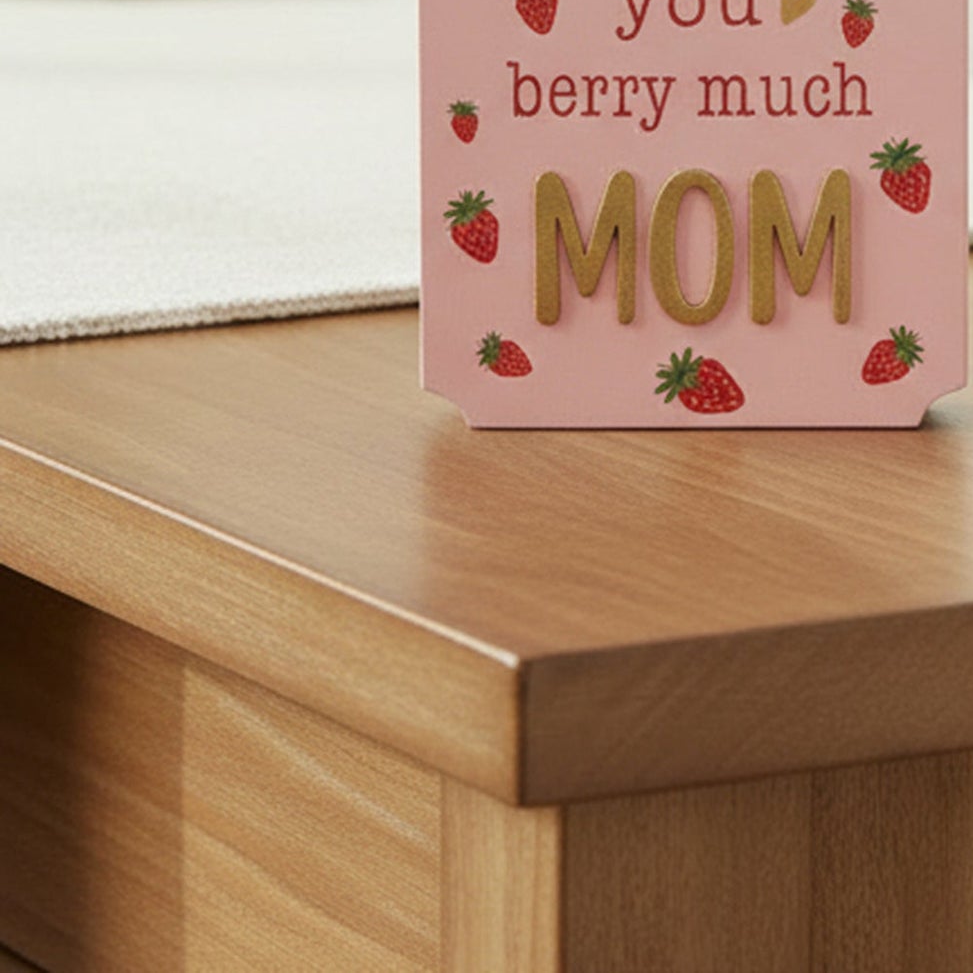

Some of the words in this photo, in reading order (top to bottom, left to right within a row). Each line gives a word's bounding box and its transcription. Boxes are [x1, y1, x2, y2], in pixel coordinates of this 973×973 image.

[506, 61, 677, 132] berry
[697, 61, 874, 118] much
[534, 169, 853, 325] MOM
